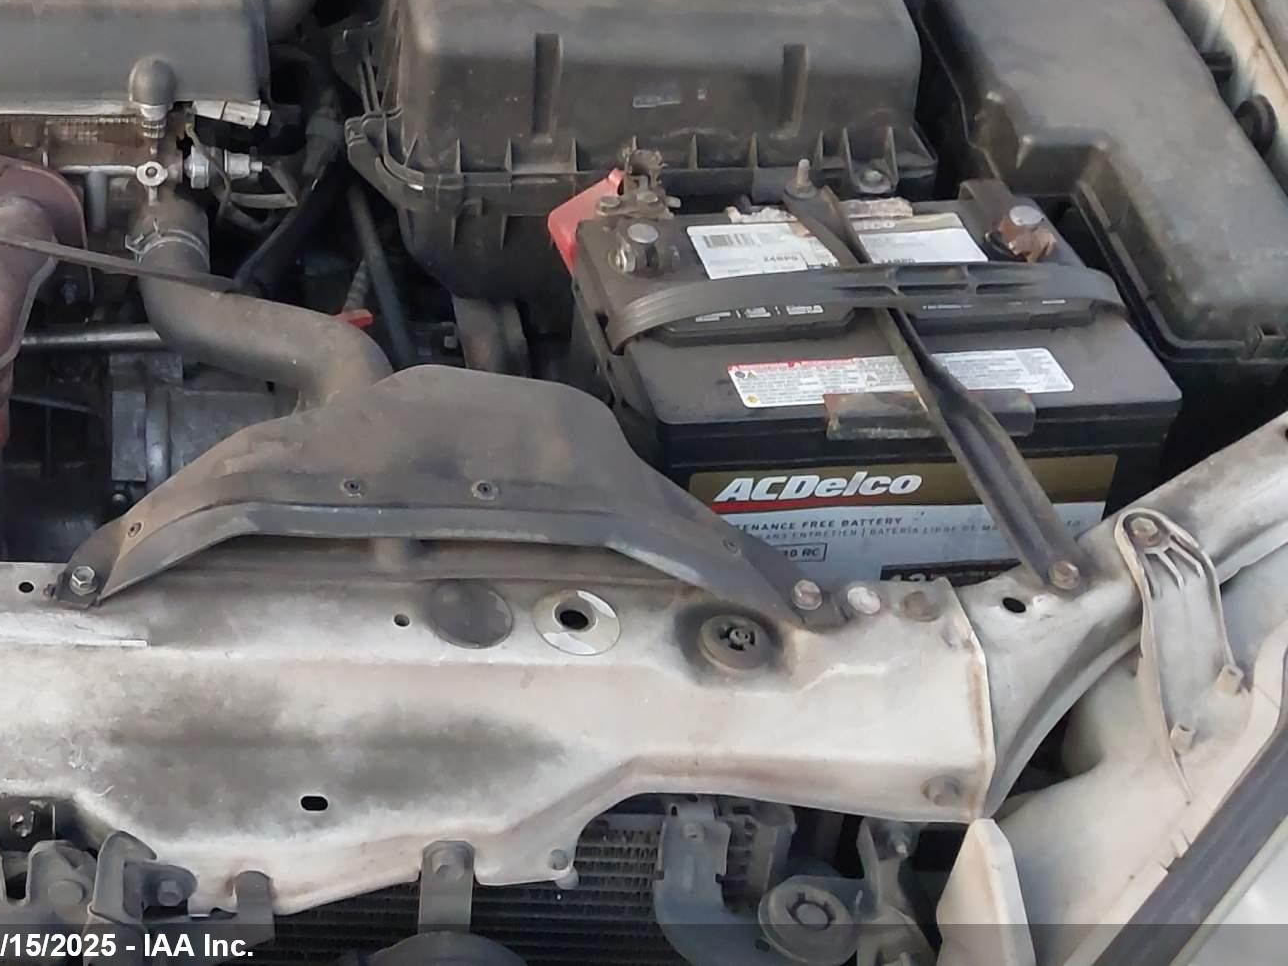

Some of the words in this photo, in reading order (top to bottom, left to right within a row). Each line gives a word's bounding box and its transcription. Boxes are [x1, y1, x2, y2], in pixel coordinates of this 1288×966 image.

[713, 471, 923, 502] ACDelco
[802, 520, 835, 528] FREE
[841, 517, 903, 527] BATTERY
[801, 547, 821, 557] RC
